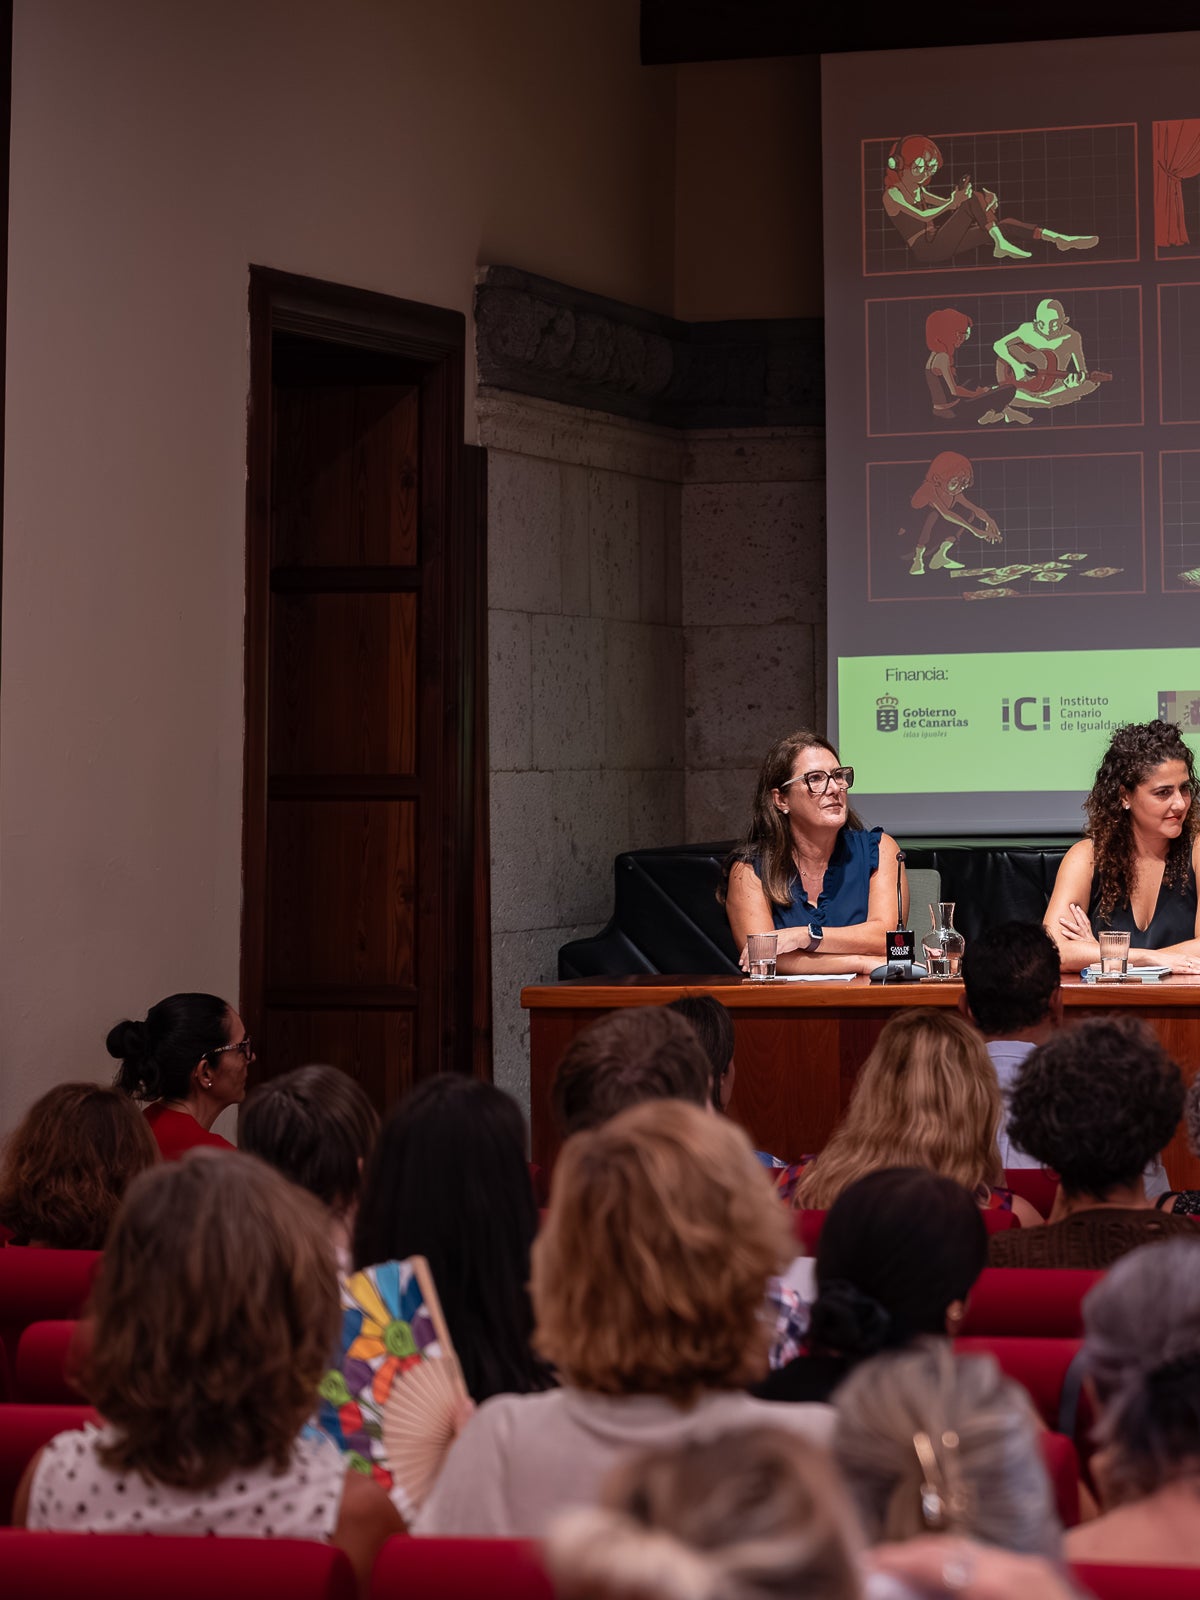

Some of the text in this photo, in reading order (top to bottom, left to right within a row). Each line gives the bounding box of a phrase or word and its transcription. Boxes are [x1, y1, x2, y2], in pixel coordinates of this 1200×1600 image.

[885, 667, 949, 682] Financia:
[1060, 695, 1109, 707] Instituto
[903, 707, 957, 718] Gobierno
[1060, 708, 1102, 719] Canario
[903, 717, 969, 728] de Canarias
[1060, 720, 1126, 732] de Igualdad
